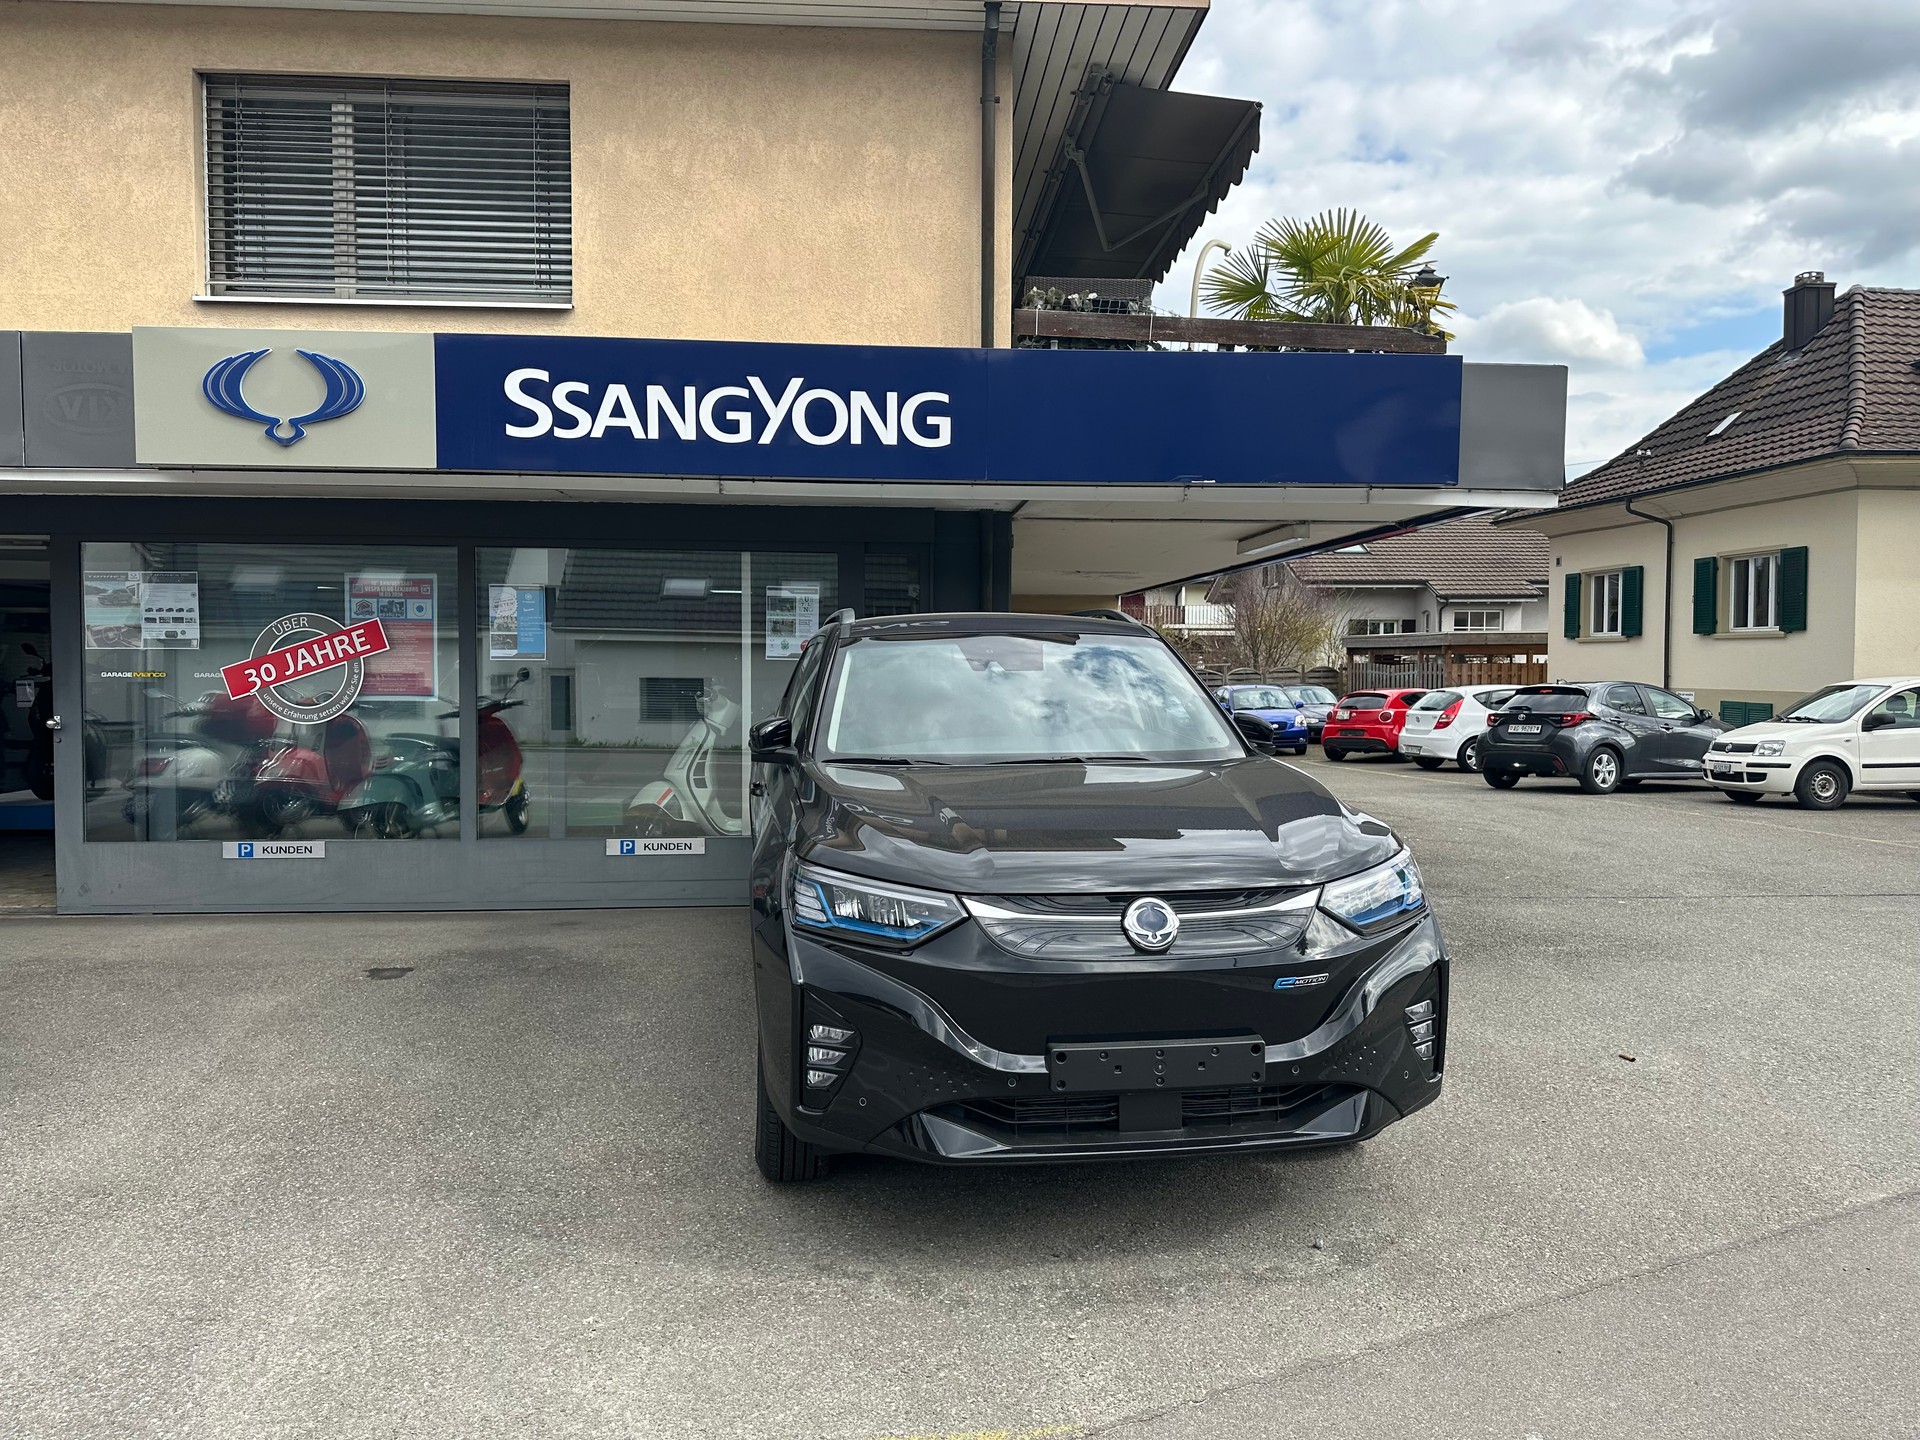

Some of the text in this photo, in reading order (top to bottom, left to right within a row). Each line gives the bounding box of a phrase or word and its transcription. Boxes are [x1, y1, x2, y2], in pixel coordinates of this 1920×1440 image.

[503, 367, 953, 448] SSANGYONG
[272, 616, 309, 636] ÜBER
[244, 663, 277, 694] 30
[284, 628, 371, 677] JAHRE
[350, 673, 359, 686] Sie
[347, 685, 356, 696] für
[263, 692, 283, 713] unsere
[340, 694, 350, 706] wir
[283, 708, 319, 721] Erfahrung
[318, 702, 341, 718] setzen
[262, 845, 313, 855] KUNDEN
[643, 842, 693, 851] KUNDEN
